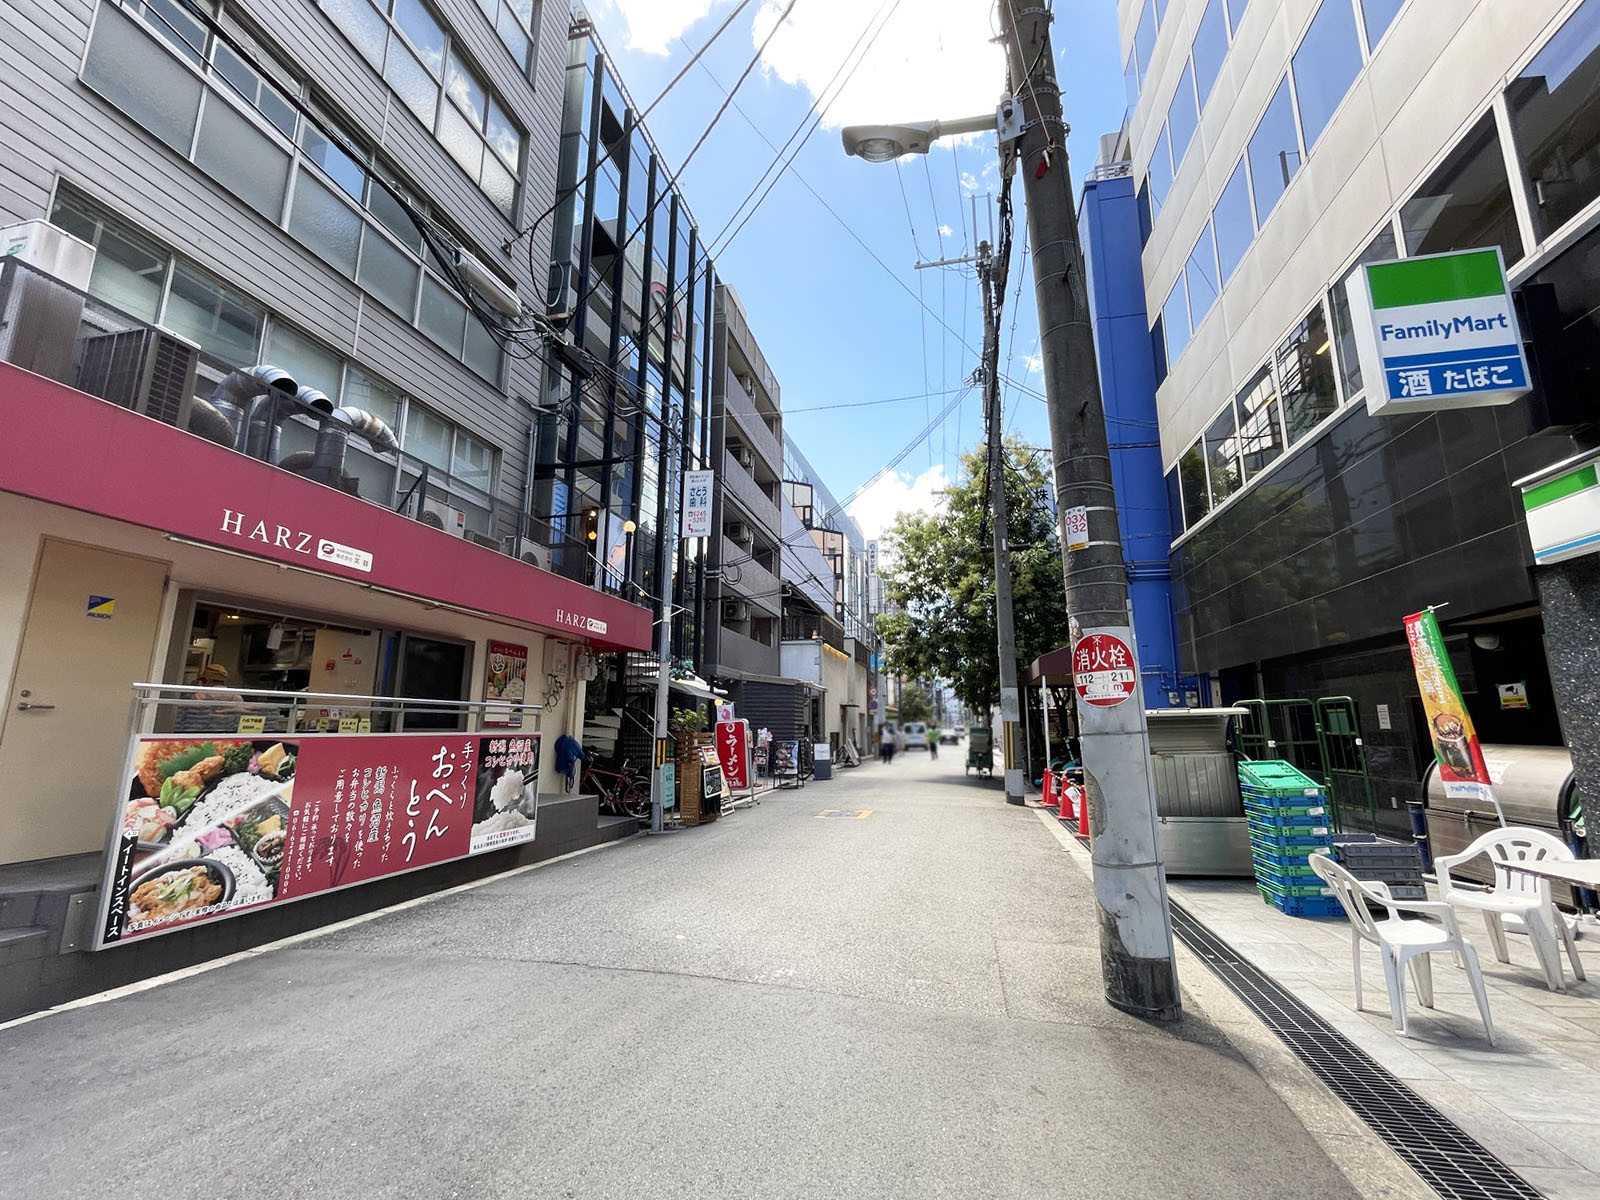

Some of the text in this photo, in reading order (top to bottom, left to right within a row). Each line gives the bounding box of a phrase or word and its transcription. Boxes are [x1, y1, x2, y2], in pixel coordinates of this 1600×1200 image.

[1379, 312, 1509, 342] FamilyMart
[1397, 365, 1514, 397] 酒 たばこ
[689, 486, 708, 497] さとう
[220, 508, 313, 555] HARZ
[1066, 513, 1087, 526] 03X
[1067, 522, 1087, 535] 132
[556, 608, 586, 629] HARZ
[1076, 644, 1127, 671] 消火栓
[460, 741, 475, 809] 手づくり
[725, 733, 739, 777] ラーメン
[344, 767, 360, 843] お弁当の数々を
[424, 745, 456, 841] おべん
[324, 768, 346, 868] ご用意しております
[401, 779, 421, 863] とう
[106, 843, 133, 939] イートインスペース
